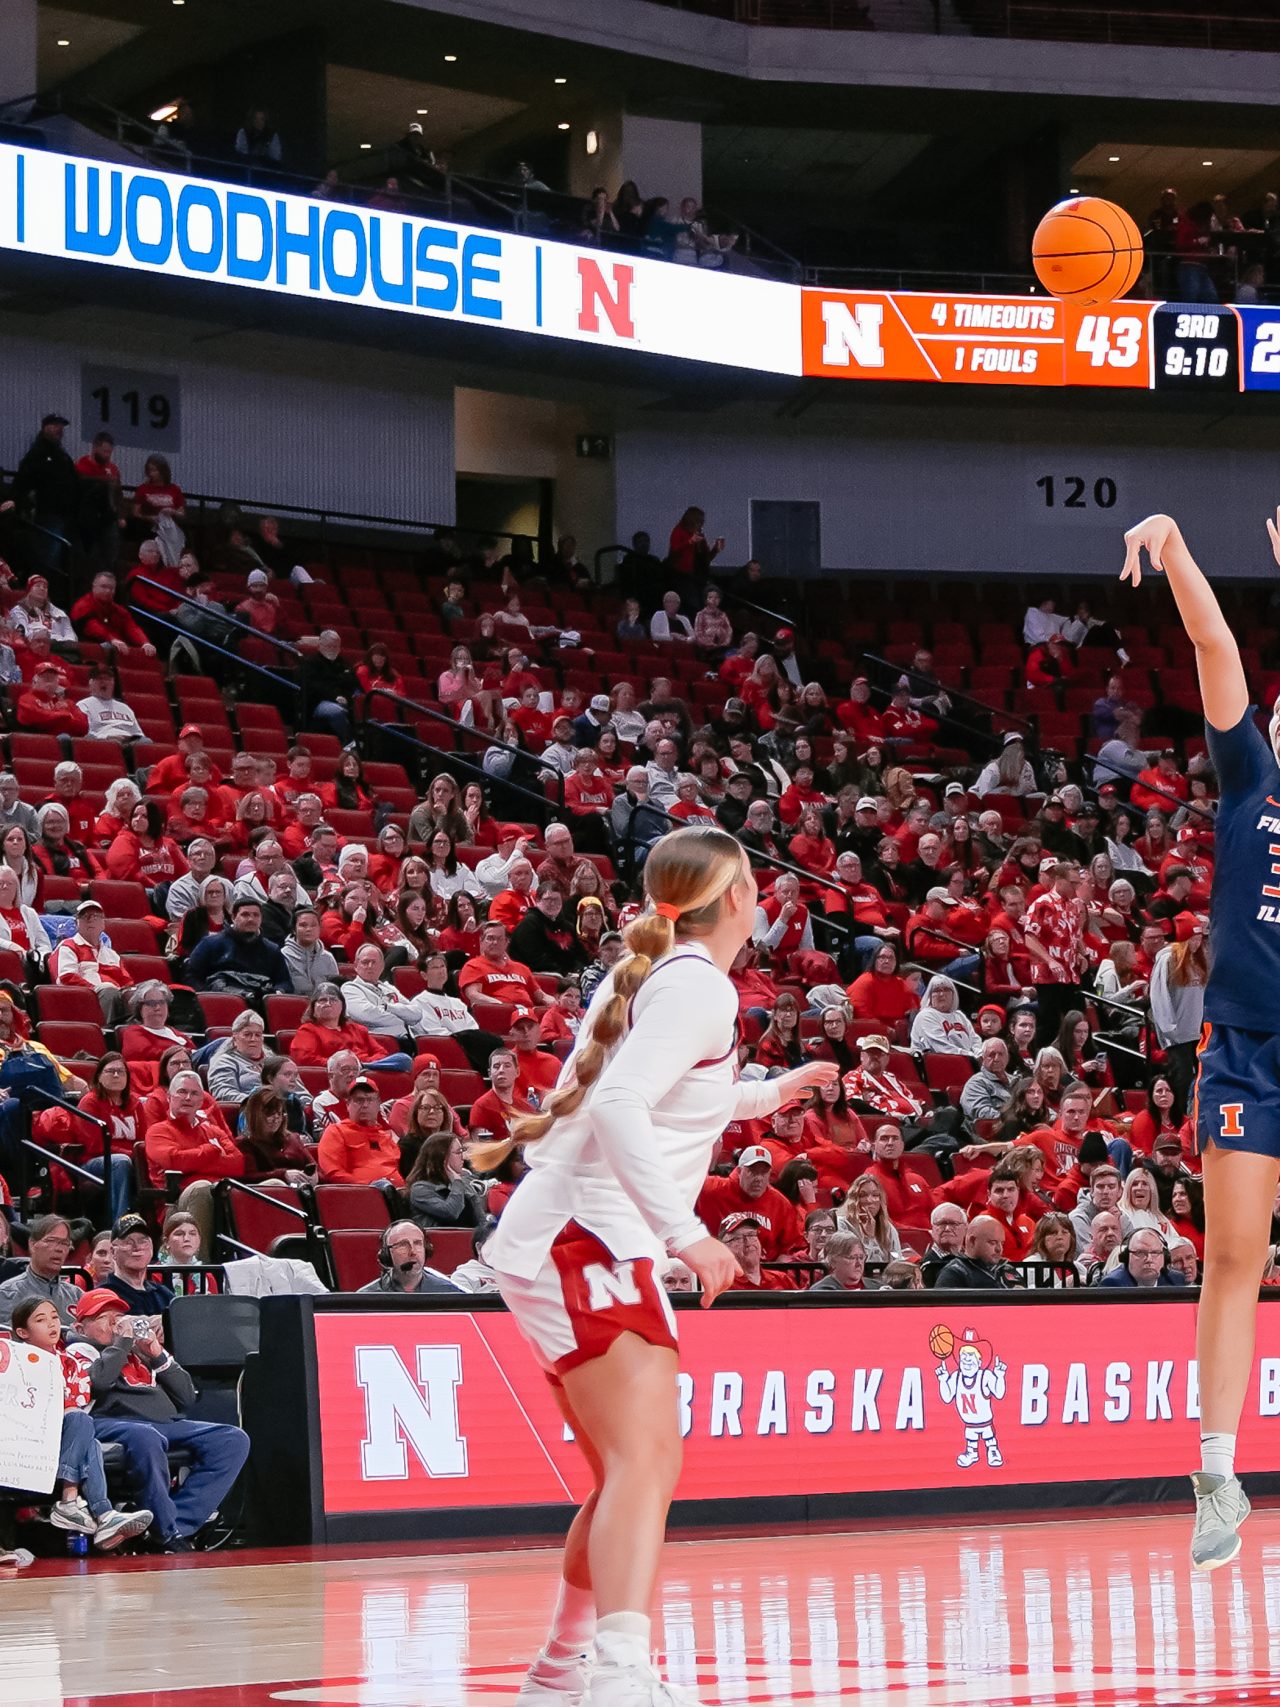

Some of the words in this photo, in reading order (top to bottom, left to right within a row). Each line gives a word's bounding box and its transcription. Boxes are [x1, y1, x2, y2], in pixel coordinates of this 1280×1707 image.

[64, 162, 503, 320] WOODHOUSE
[576, 255, 635, 340] N
[931, 304, 946, 328] 4
[953, 303, 1056, 330] TIMEOUTS
[821, 301, 884, 368] N
[1075, 315, 1142, 369] 43
[1175, 314, 1220, 340] 3RD
[954, 347, 966, 371] 1
[970, 347, 1038, 374] FOULS
[1165, 347, 1229, 378] 9:10
[91, 385, 171, 430] 119
[1035, 475, 1118, 509] 120
[517, 1005, 529, 1016] N
[110, 1114, 136, 1141] N
[584, 1260, 643, 1312] N
[354, 1343, 470, 1482] N
[562, 1366, 926, 1442] BRASKA
